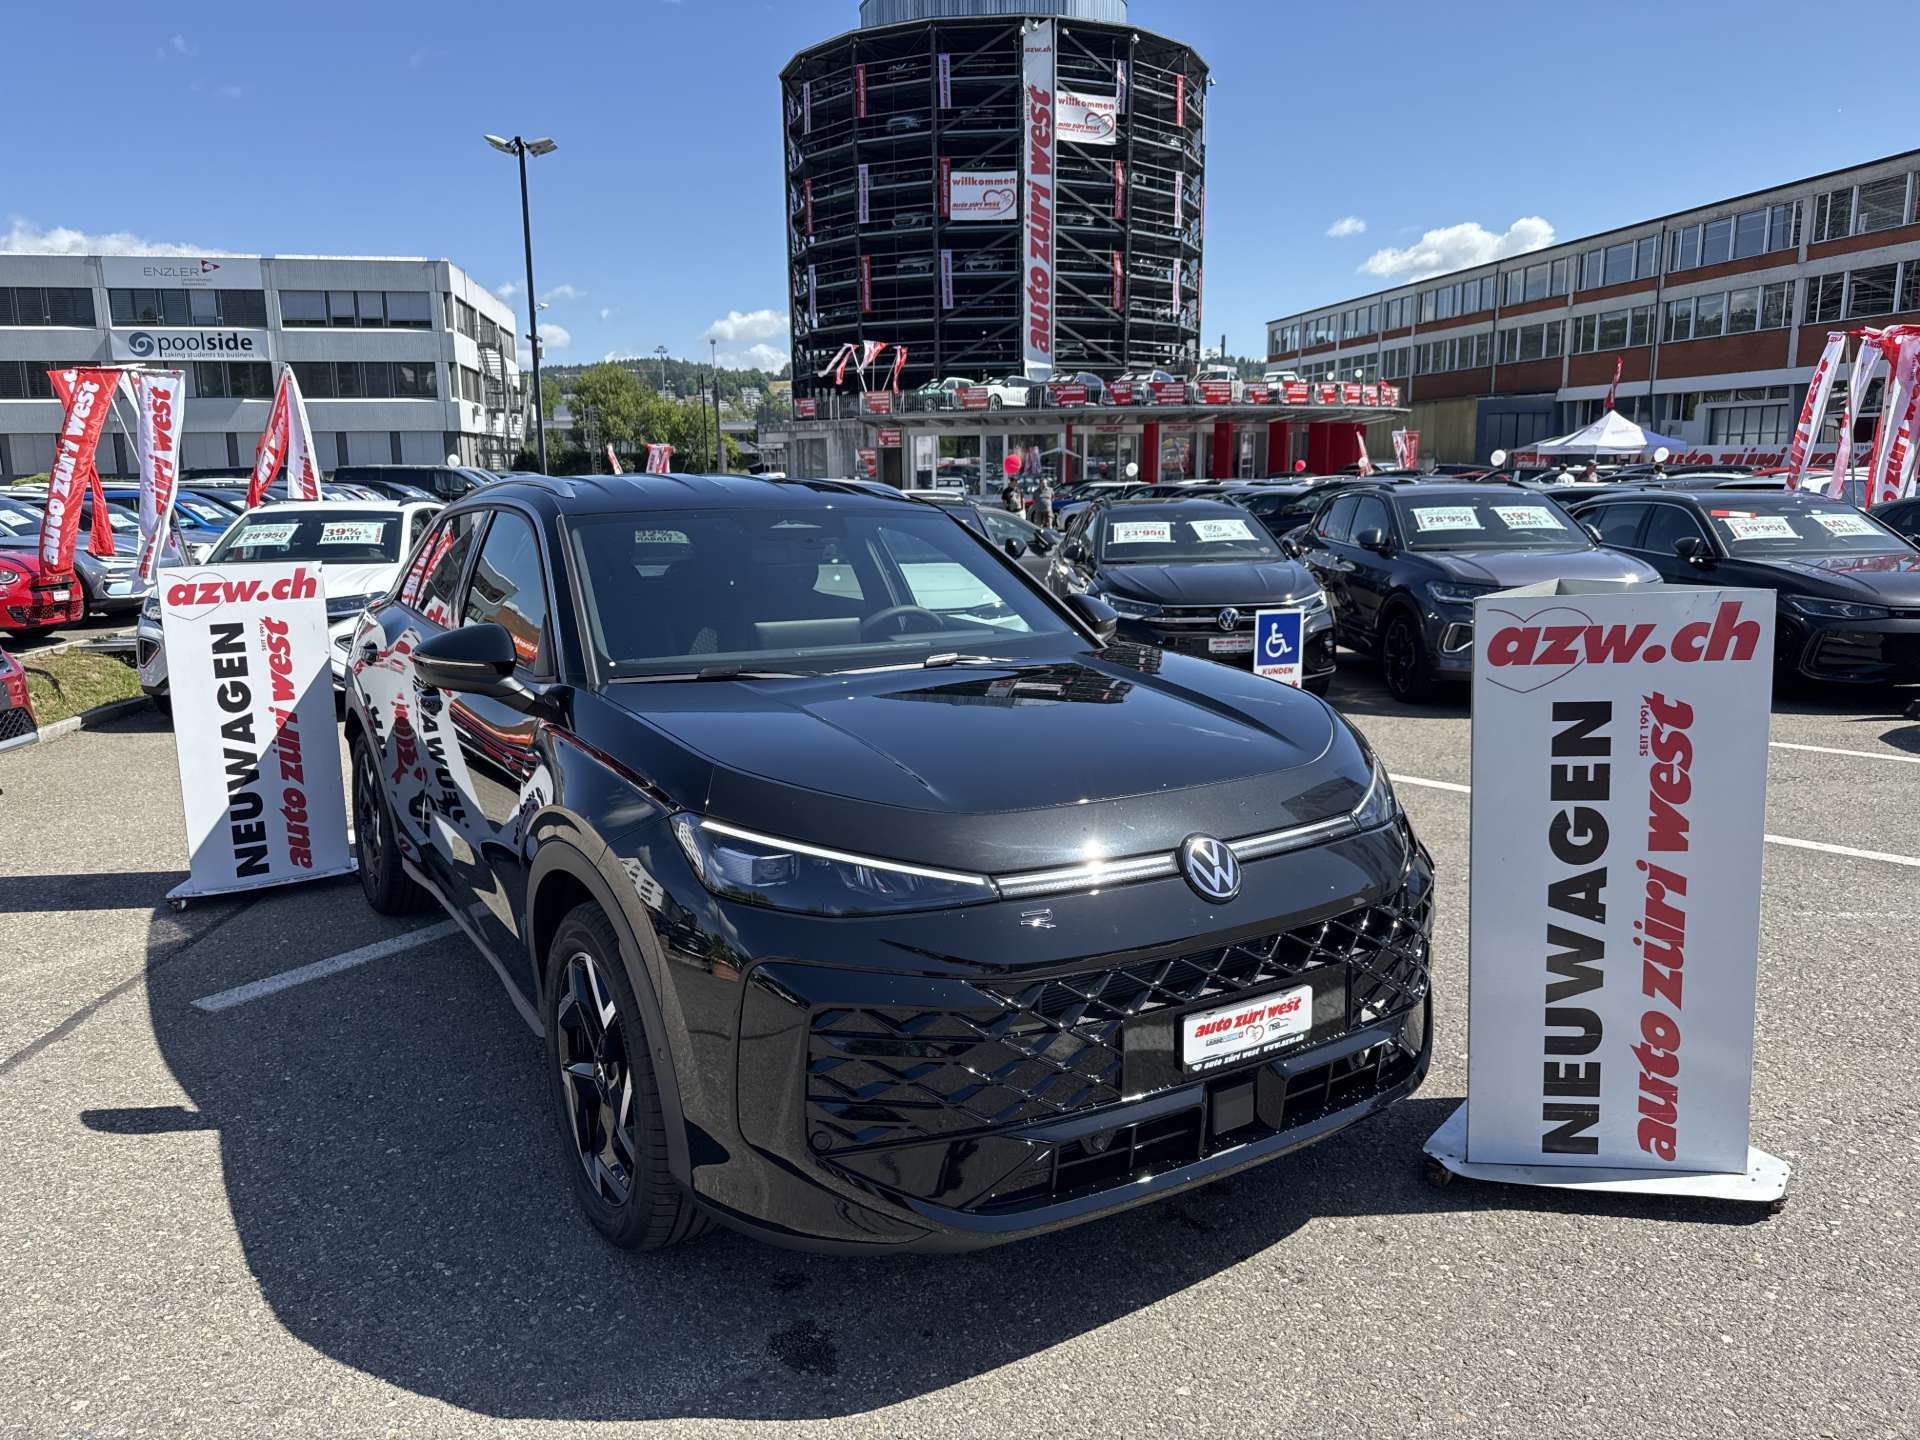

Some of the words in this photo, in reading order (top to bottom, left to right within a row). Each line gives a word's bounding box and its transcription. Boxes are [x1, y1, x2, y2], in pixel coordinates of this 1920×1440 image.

[1027, 84, 1051, 174] west
[1057, 97, 1115, 110] willkommen
[952, 176, 1016, 186] willkommen
[1026, 179, 1050, 264] züri
[143, 267, 200, 277] ENZLER
[1026, 266, 1050, 353] auto
[157, 332, 253, 358] poolside
[164, 351, 186, 359] taking
[66, 381, 100, 436] west
[150, 386, 172, 451] west
[245, 531, 288, 540] 28'950
[324, 527, 362, 537] 39%
[167, 568, 317, 607] azw.ch
[260, 616, 296, 701] west
[1487, 601, 1761, 667] azw.ch
[1262, 666, 1294, 675] KUNDEN
[268, 706, 305, 785] züri
[1640, 704, 1650, 733] 1991
[1640, 735, 1649, 757] SEIT
[209, 622, 270, 878] NEUWAGEN
[1642, 691, 1694, 852] west
[280, 787, 313, 869] auto
[1541, 701, 1613, 1155] NEUWAGEN
[1632, 859, 1687, 1010] züri
[1195, 1016, 1232, 1038] auto
[1233, 1005, 1267, 1028] züri
[1267, 997, 1302, 1019] west
[1630, 1010, 1681, 1162] auto
